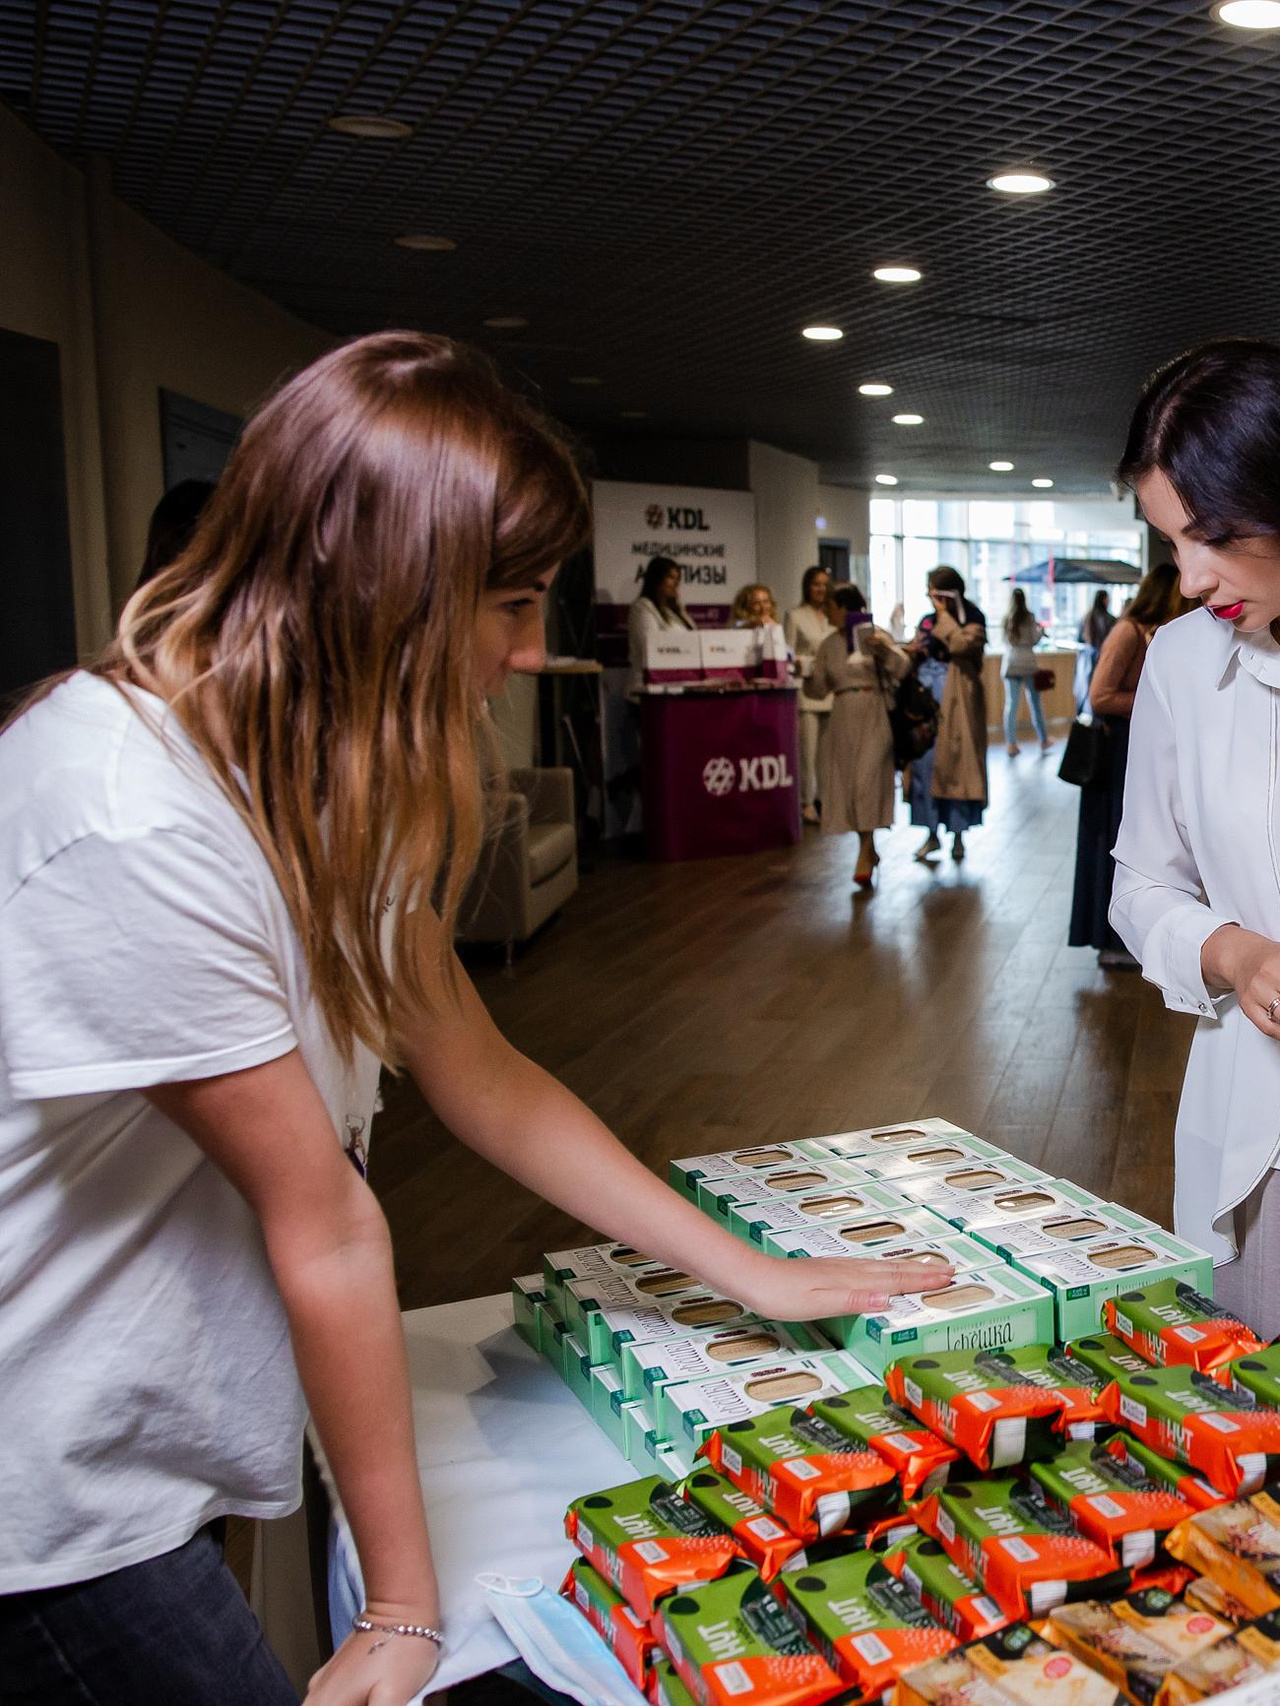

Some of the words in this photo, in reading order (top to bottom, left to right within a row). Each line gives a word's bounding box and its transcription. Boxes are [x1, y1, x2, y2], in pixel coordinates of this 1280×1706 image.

[667, 507, 709, 530] KDL
[631, 541, 725, 558] МЕДИЦИНСКИЕ
[634, 564, 727, 585] АЛИЗЫ
[738, 753, 793, 792] KDL
